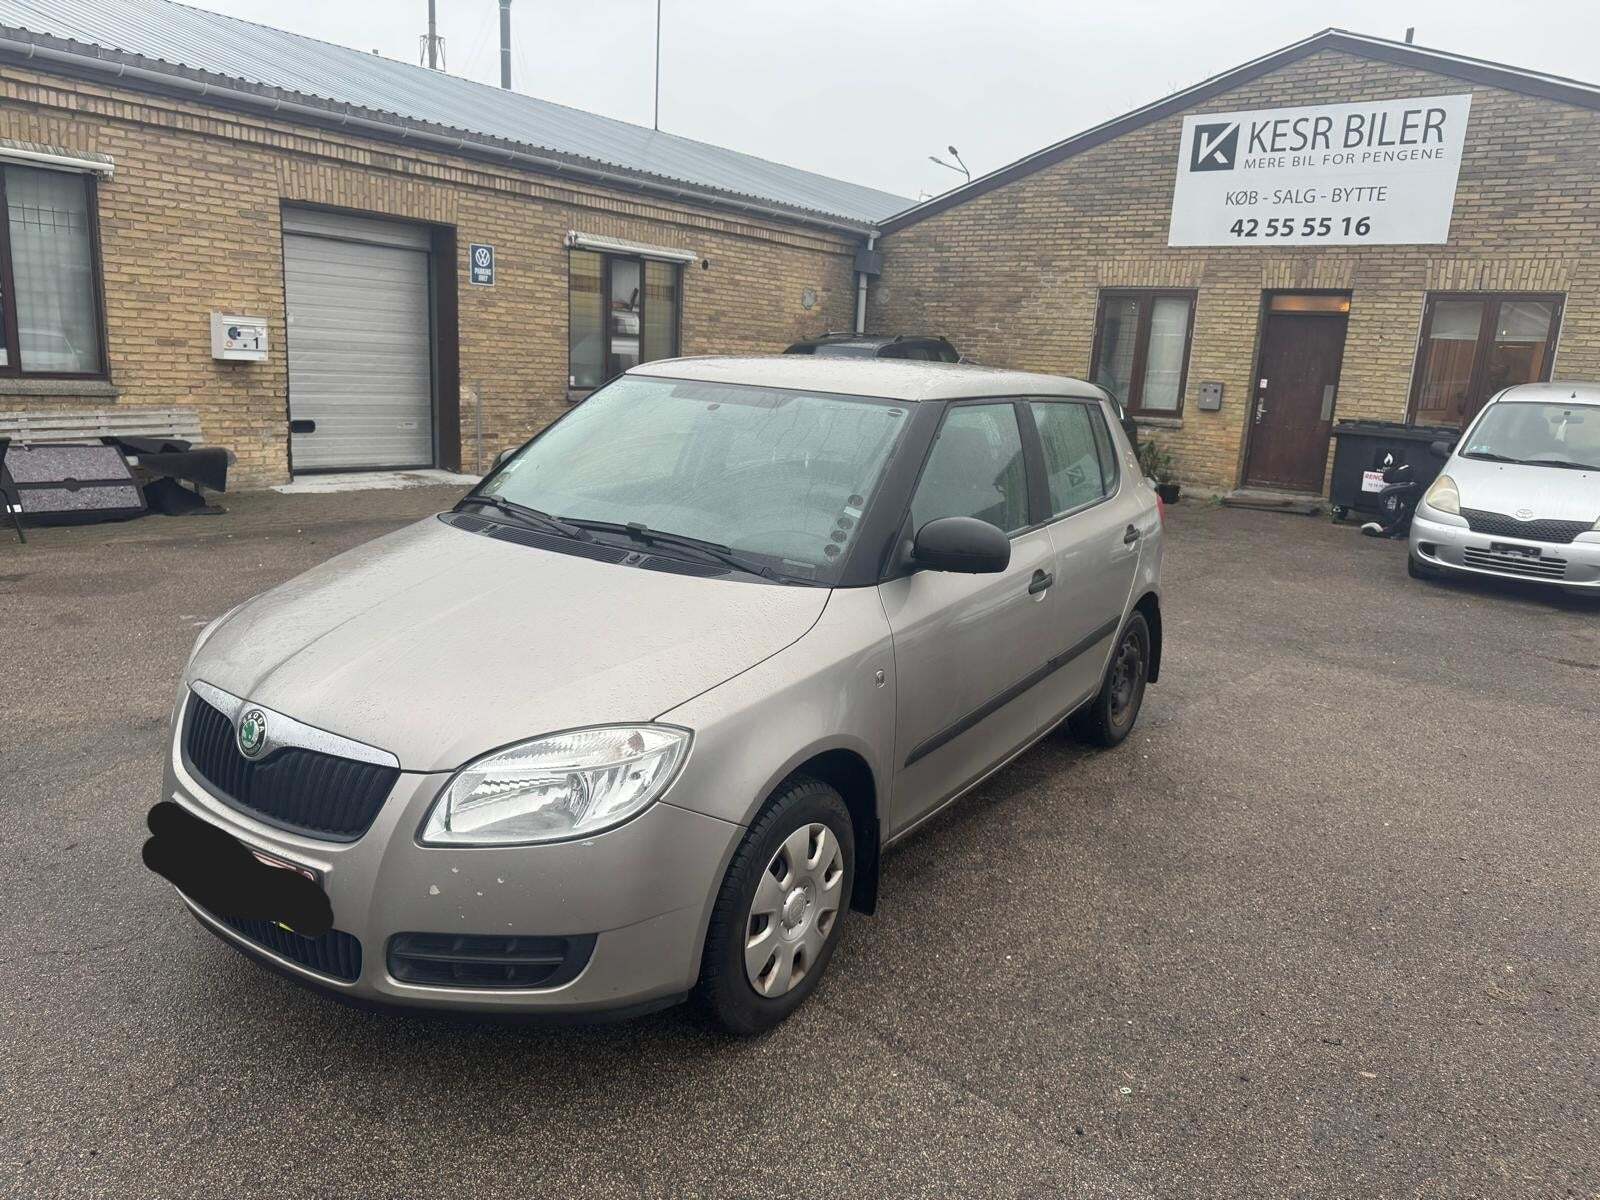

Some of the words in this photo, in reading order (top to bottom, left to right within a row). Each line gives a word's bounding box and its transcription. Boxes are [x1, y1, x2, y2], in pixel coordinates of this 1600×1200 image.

[1248, 116, 1333, 153] KESR
[1343, 108, 1447, 148] BILER
[1244, 157, 1285, 169] MERE
[1292, 155, 1316, 167] BIL
[1322, 153, 1355, 165] FOR
[1362, 148, 1444, 163] PENGENE
[1225, 190, 1258, 206] KØB
[1272, 188, 1316, 205] SALG
[1331, 186, 1387, 203] BYTTE
[1230, 218, 1259, 237] 42
[1265, 217, 1295, 237] 55
[1301, 217, 1332, 237] 55
[1341, 216, 1371, 236] 16
